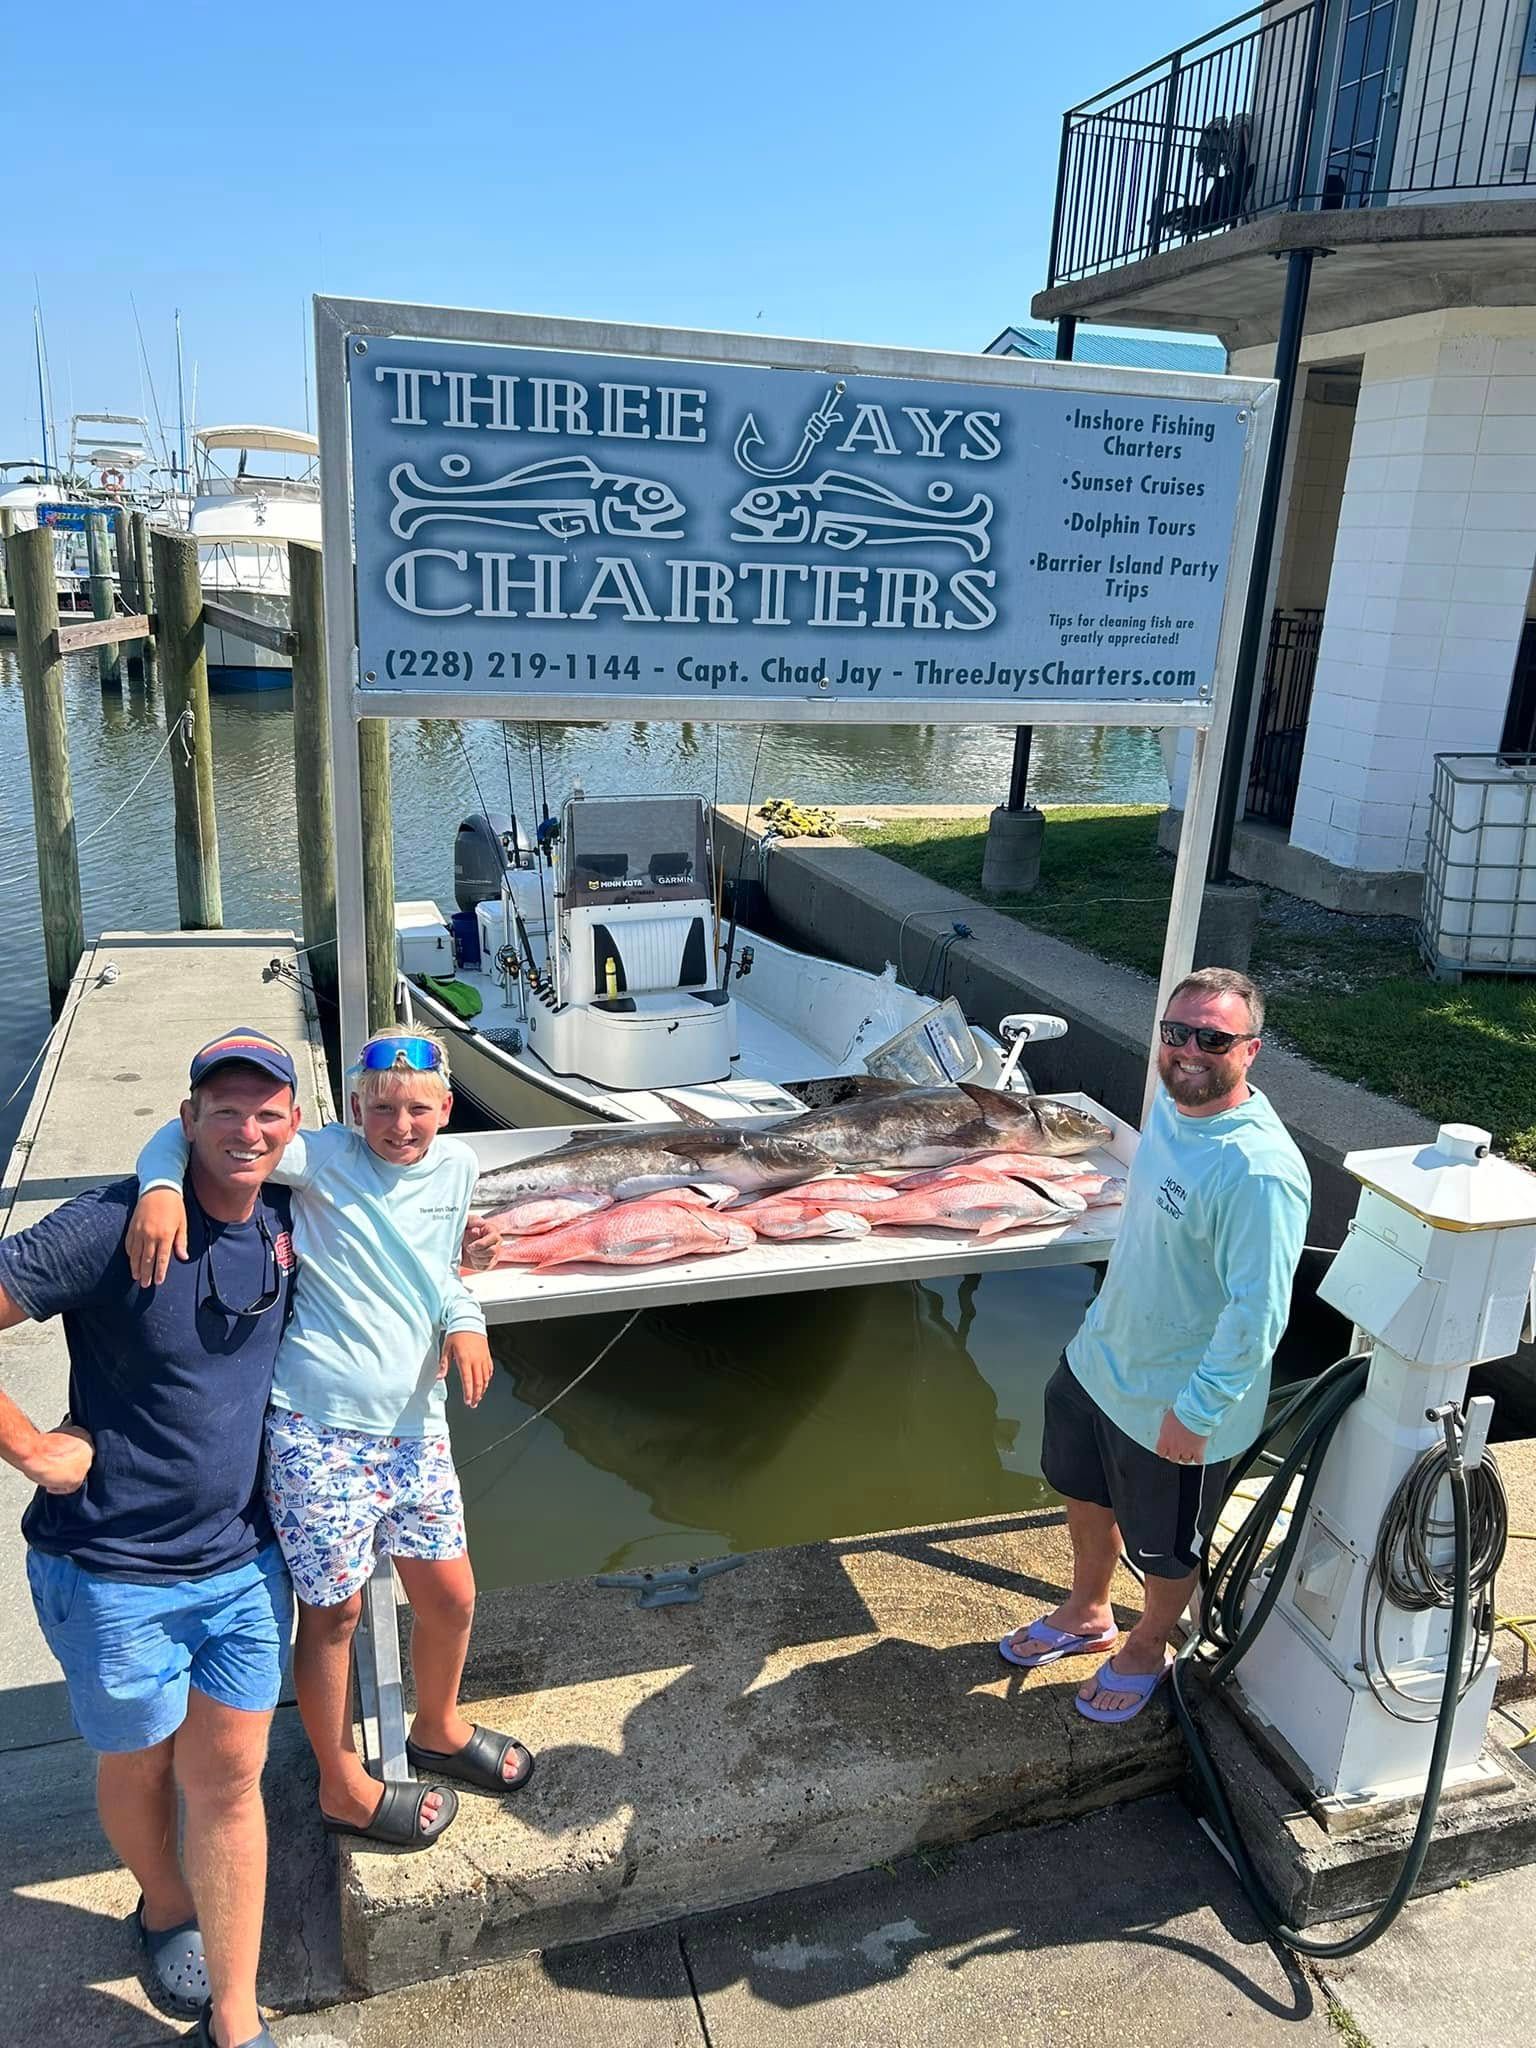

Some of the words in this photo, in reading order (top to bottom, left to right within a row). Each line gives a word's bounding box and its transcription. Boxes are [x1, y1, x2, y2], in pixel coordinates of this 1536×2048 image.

[375, 366, 707, 442] THREE
[1074, 408, 1144, 432] Inshore
[1151, 413, 1215, 442] Fishing
[1103, 435, 1182, 459] Charters
[1071, 470, 1133, 493] Sunset
[1140, 475, 1205, 496] Cruises
[1071, 511, 1140, 538] Dolphin
[1148, 516, 1196, 536] Tours
[1036, 552, 1102, 573] Barrier
[1108, 554, 1164, 575] Island
[1170, 557, 1219, 582] Party
[385, 548, 997, 631] CHARTERS
[1105, 578, 1149, 603] Trips
[1049, 613, 1073, 629] Tips
[1078, 613, 1096, 627] for
[1099, 614, 1147, 631] cleaning
[1150, 615, 1172, 629] fish
[1175, 619, 1195, 629] are
[1060, 630, 1104, 646] greatly
[1107, 632, 1179, 647] appreciated!
[385, 649, 473, 681] (228)
[488, 651, 641, 681] 219-1144
[677, 656, 749, 689] Capt.
[761, 657, 826, 684] Chad
[836, 659, 882, 691] Jay
[914, 659, 1196, 692] ThreeJaysCharters.com
[600, 880, 622, 888] MINN
[622, 879, 643, 888] KOTA
[658, 876, 694, 884] GARMIN
[1163, 1176, 1188, 1200] HORN
